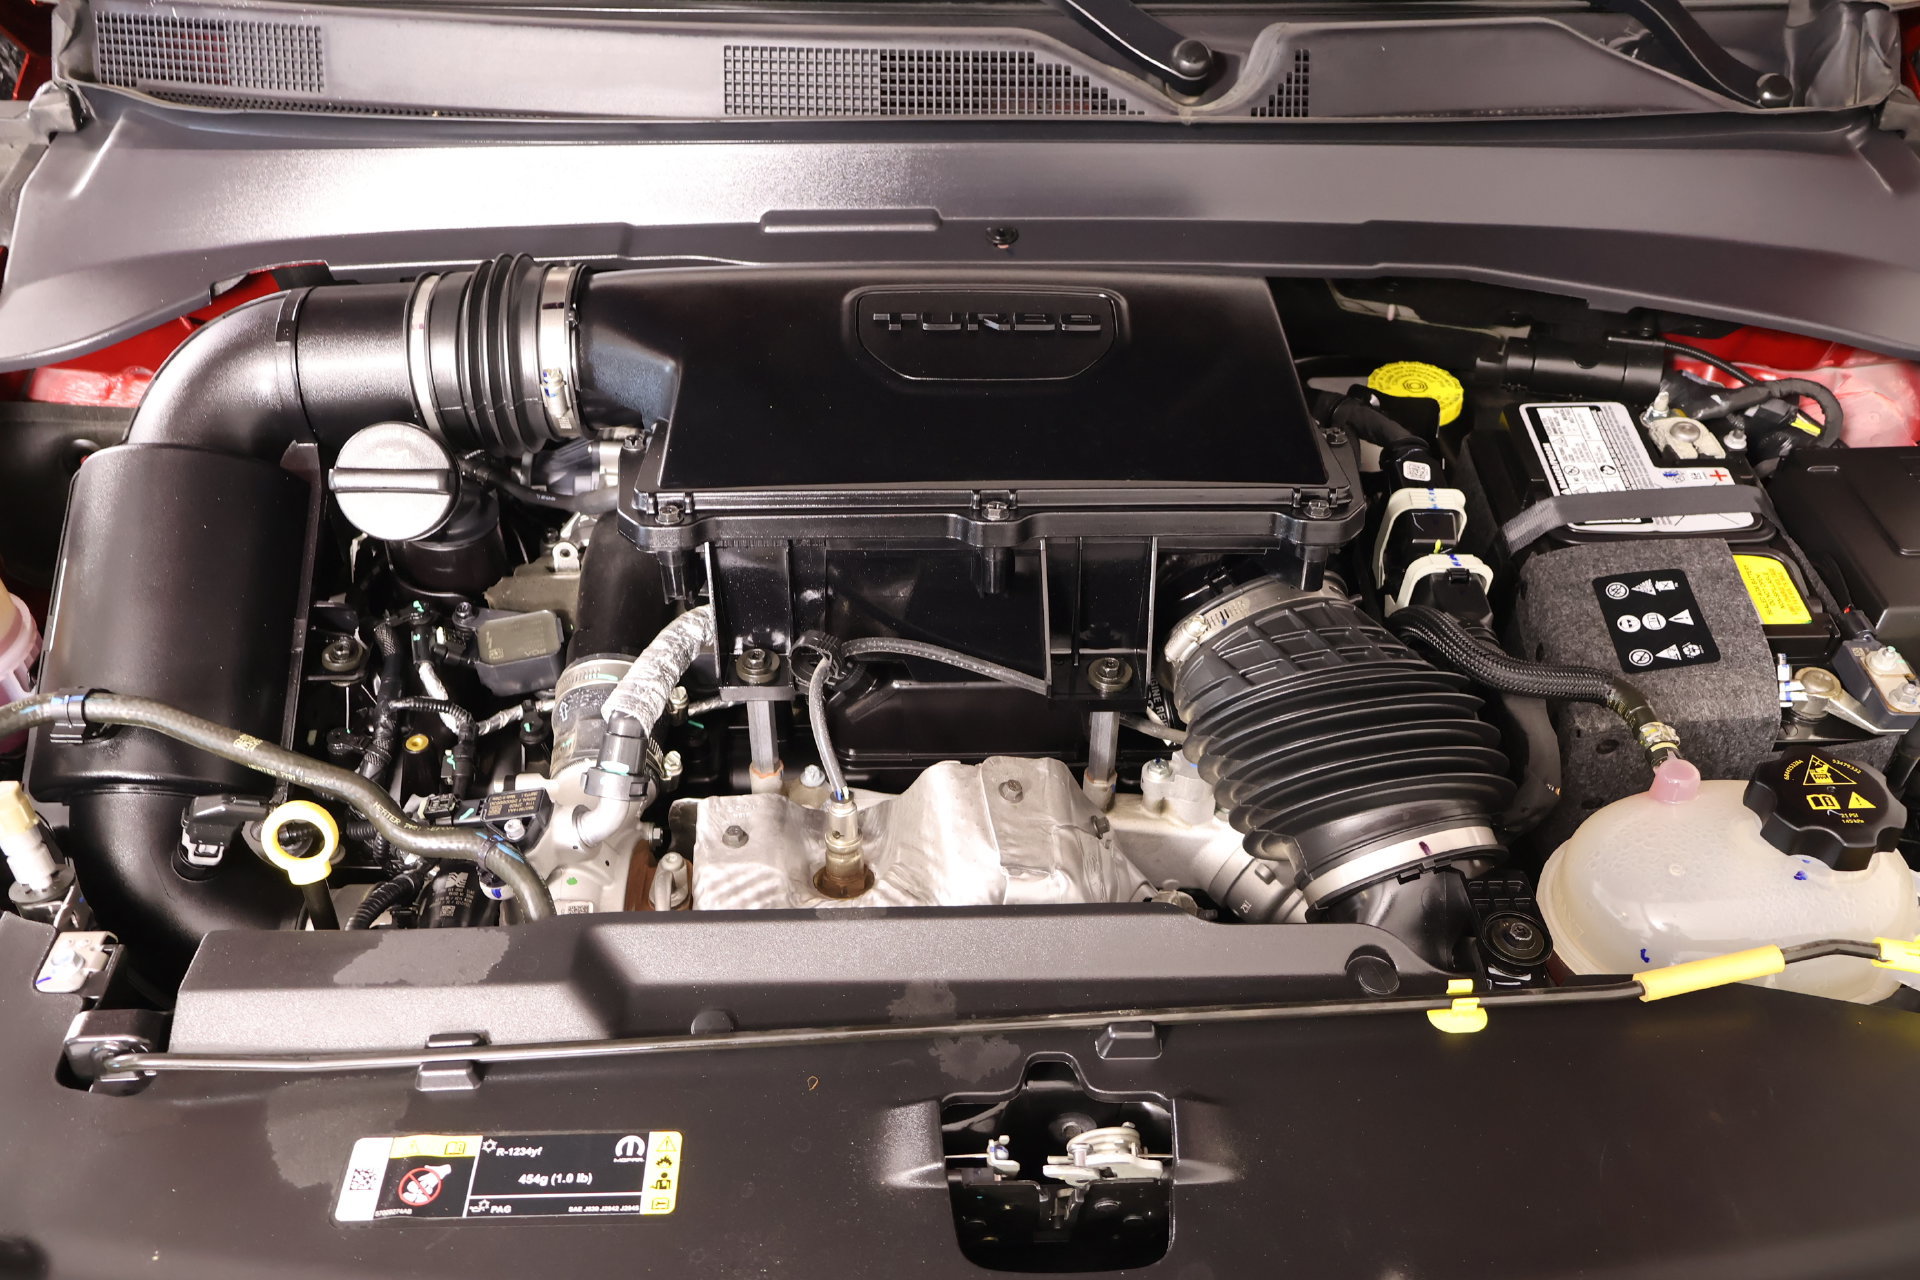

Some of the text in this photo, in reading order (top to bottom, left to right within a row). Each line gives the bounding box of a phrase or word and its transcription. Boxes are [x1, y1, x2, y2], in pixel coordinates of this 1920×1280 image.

[872, 311, 1102, 332] TURBO
[495, 1146, 543, 1158] R-1234yf
[517, 1172, 593, 1187] 454g (1.0 lb)
[490, 1204, 512, 1214] PAG
